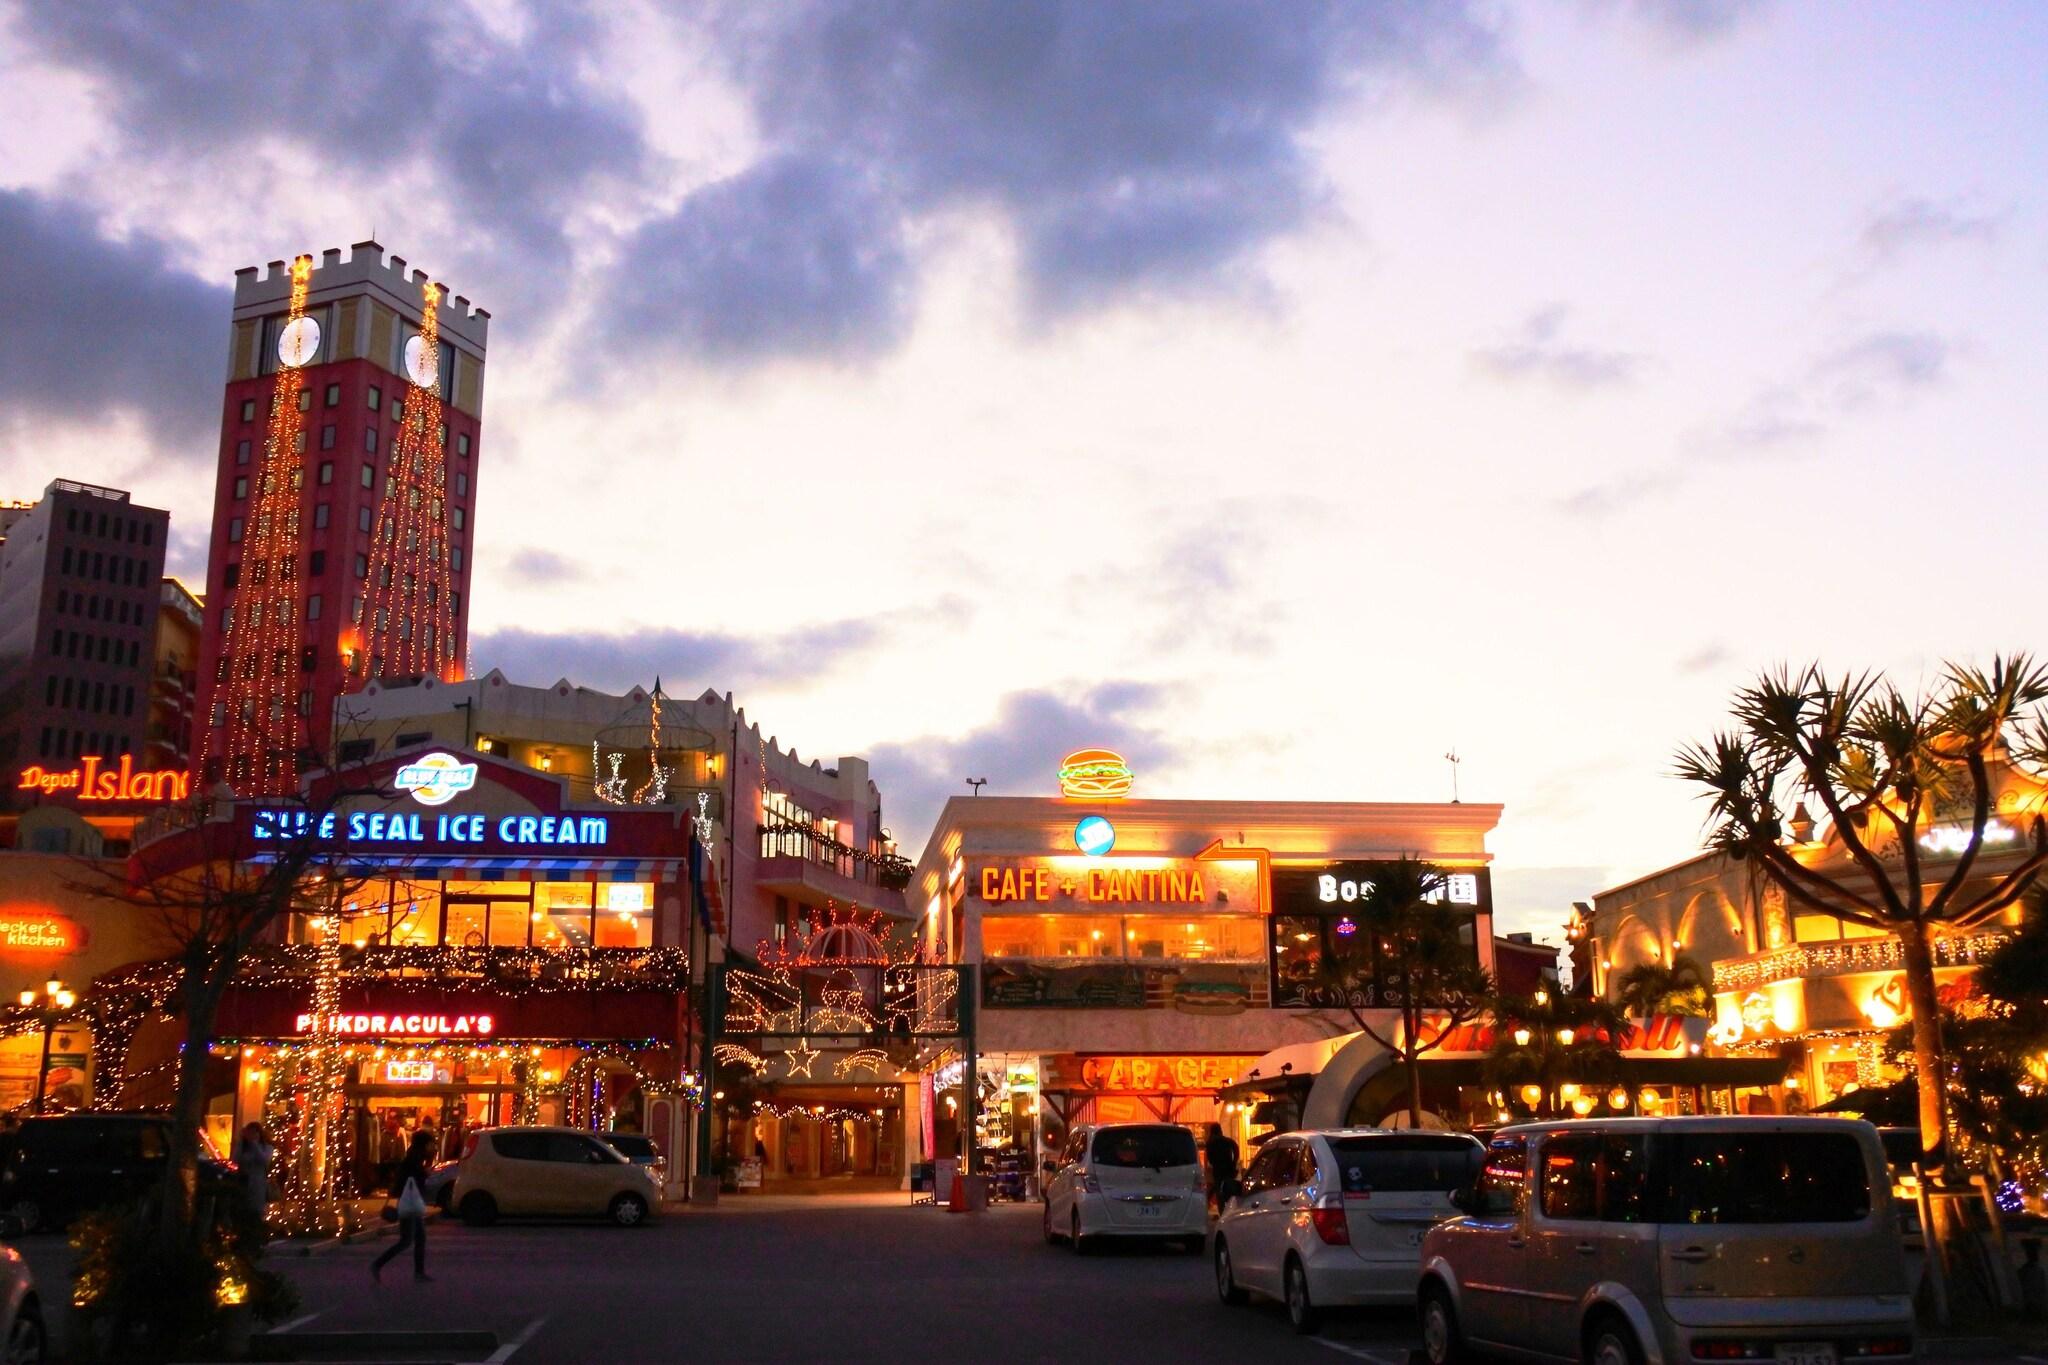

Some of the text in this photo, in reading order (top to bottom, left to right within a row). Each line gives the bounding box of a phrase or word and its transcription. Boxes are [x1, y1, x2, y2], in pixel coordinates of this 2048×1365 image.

[18, 766, 80, 794] Depot
[348, 812, 424, 841] SEAL
[437, 814, 486, 842] ICE
[982, 867, 1050, 901] CAFE
[1088, 868, 1205, 902] CANTINA
[0, 919, 58, 934] ecker's
[7, 932, 65, 947] kitchen
[389, 1063, 432, 1079] OPEN
[1082, 1057, 1223, 1091] GARAGE
